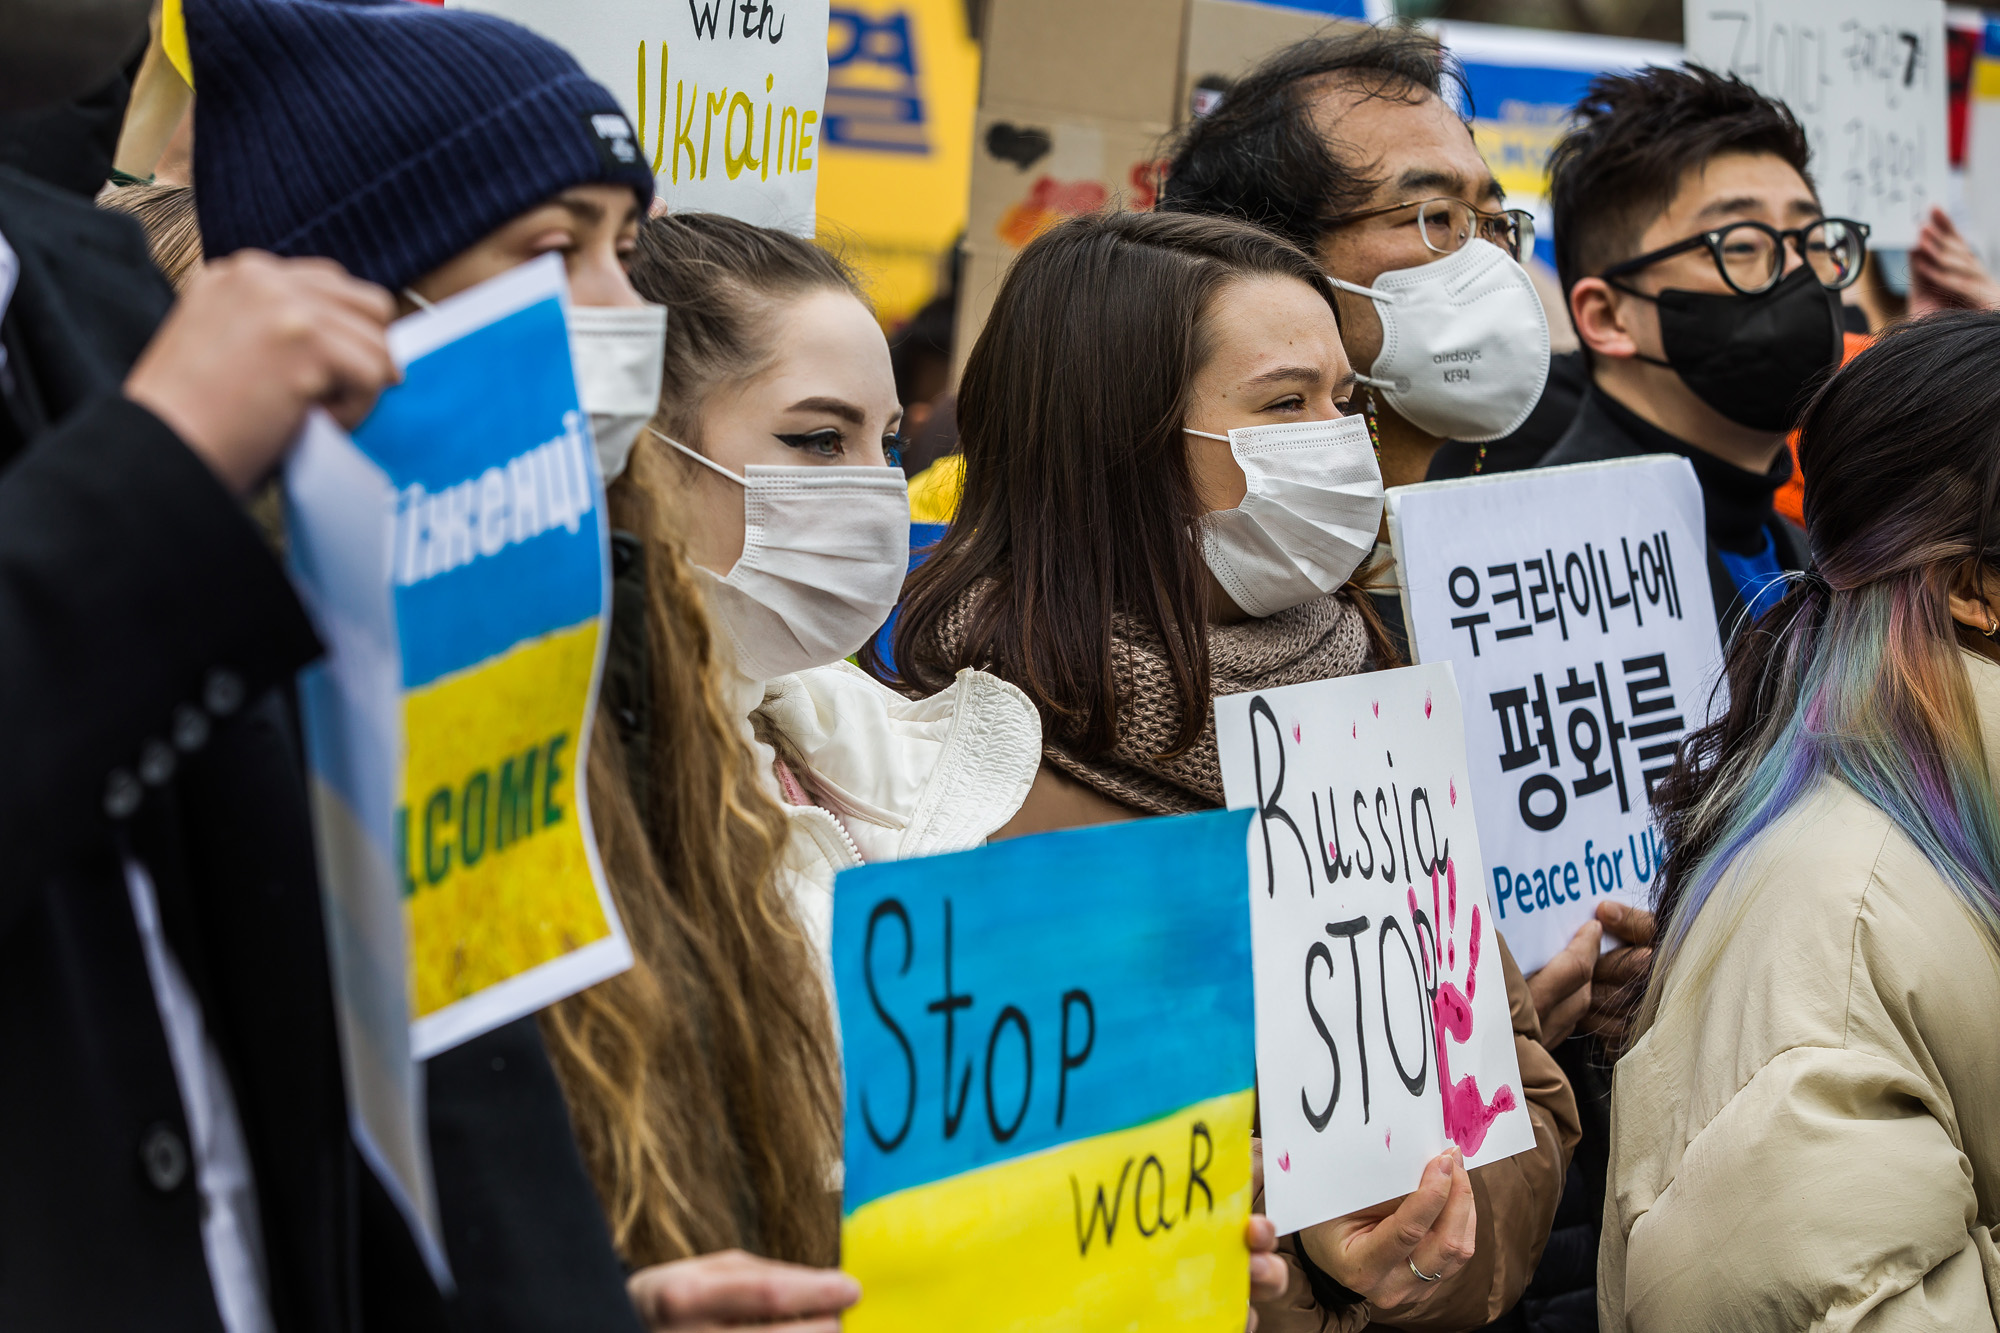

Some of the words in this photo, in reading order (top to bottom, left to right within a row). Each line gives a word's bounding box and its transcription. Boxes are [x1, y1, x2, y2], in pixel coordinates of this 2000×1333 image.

[1432, 349, 1482, 364] airdays
[1443, 368, 1471, 383] KF94
[402, 409, 592, 587] іженці
[1448, 530, 1683, 657] 우크라이나에
[393, 731, 569, 898] LCOME
[1249, 695, 1449, 899] Russia
[1489, 652, 1685, 832] 평화를
[1492, 865, 1581, 919] Peace
[1584, 839, 1624, 896] for
[1628, 825, 1668, 883] Uk
[1301, 908, 1443, 1133] STOP
